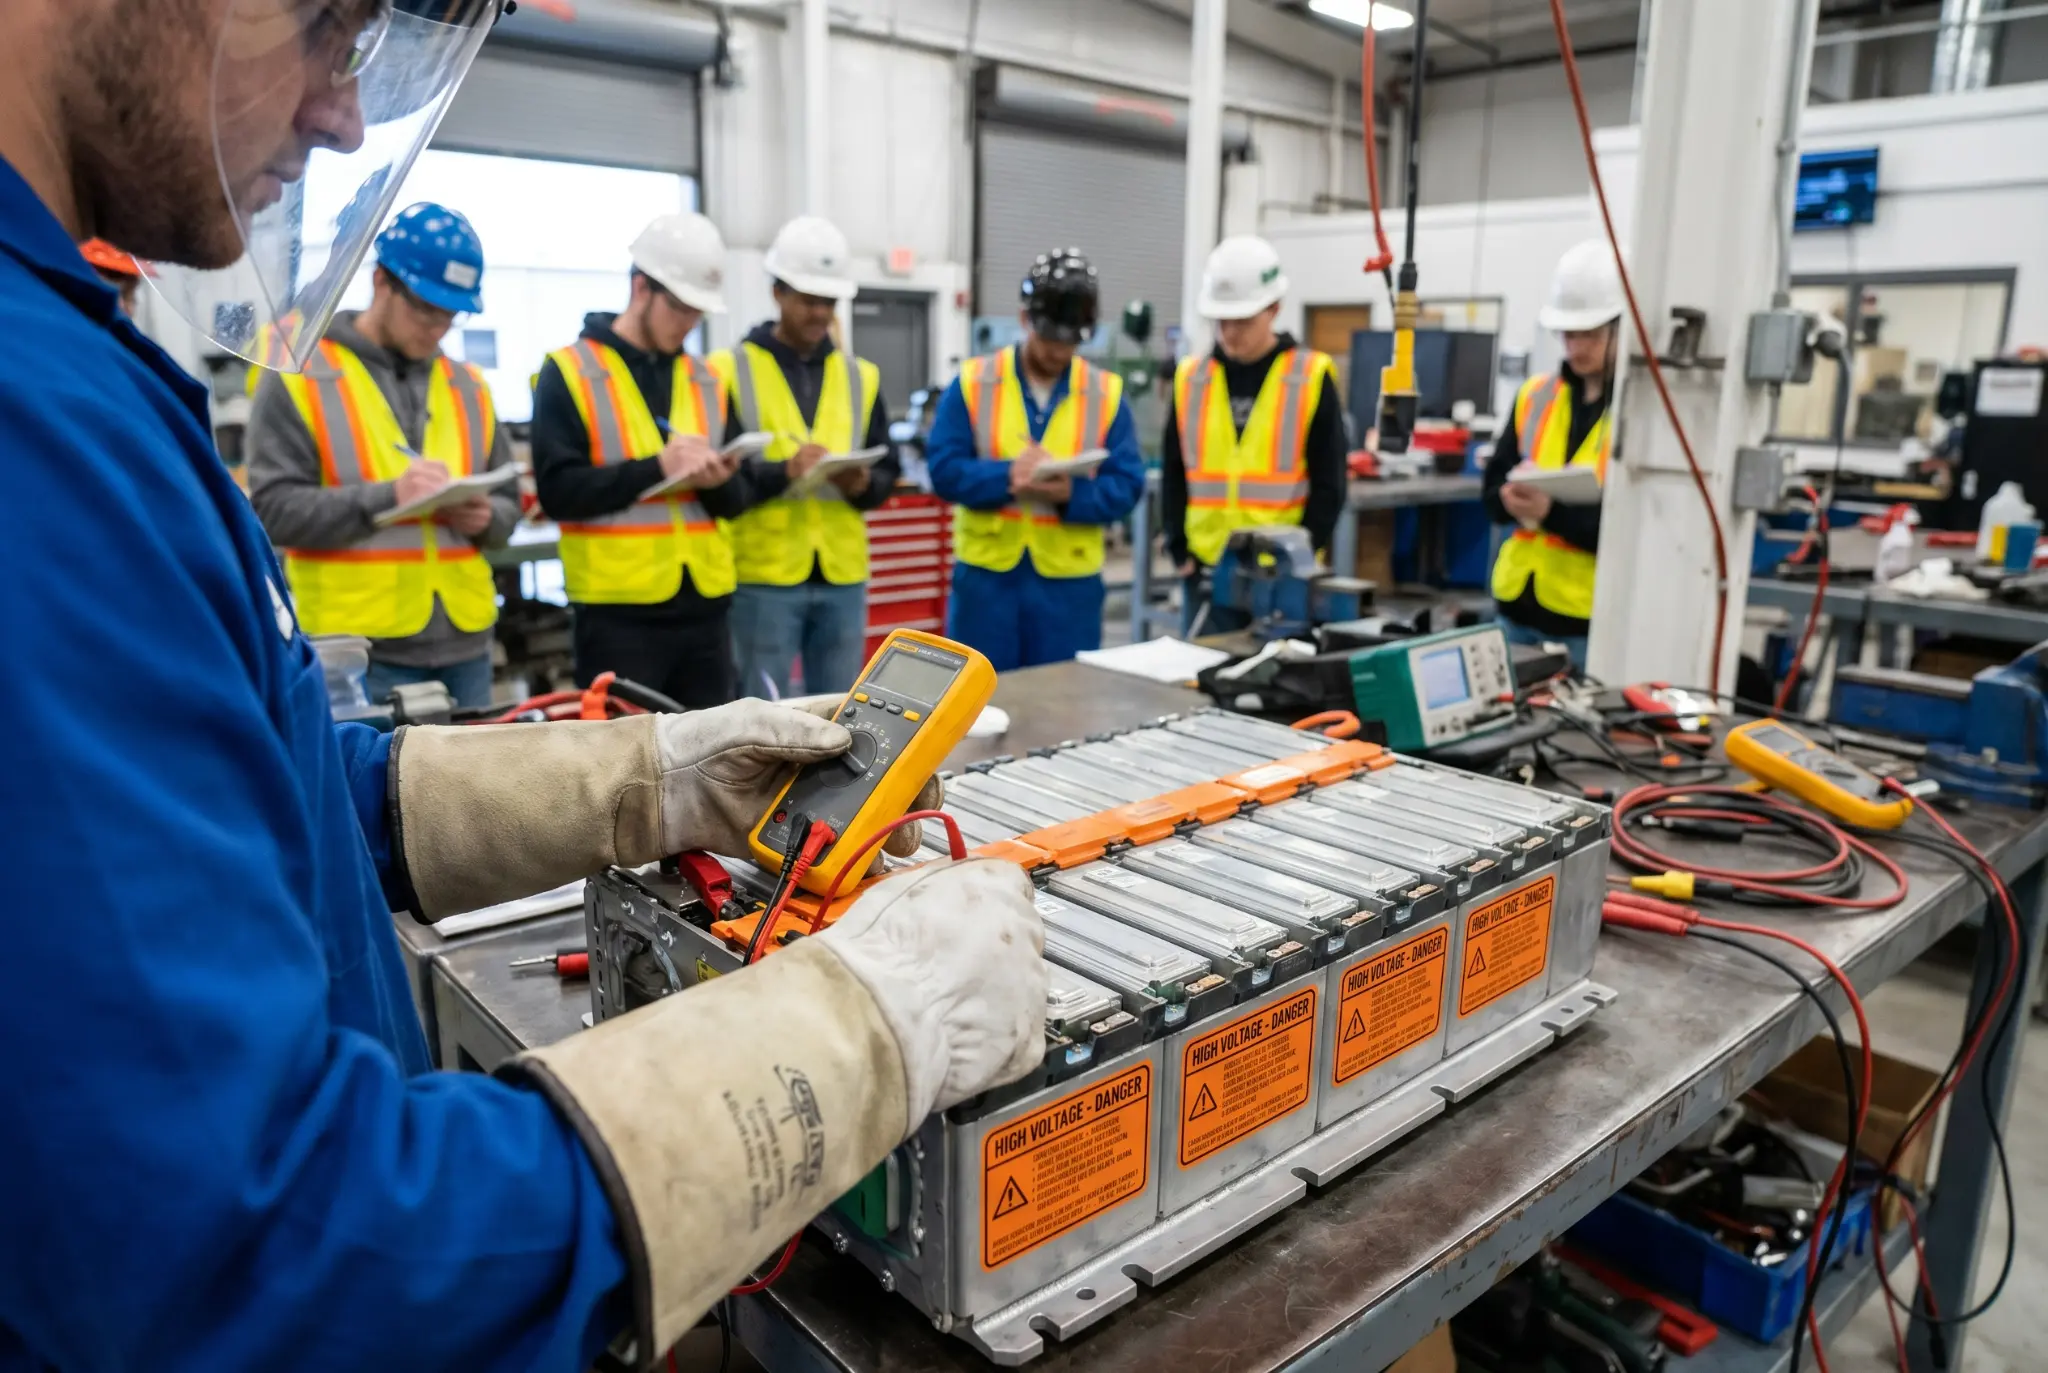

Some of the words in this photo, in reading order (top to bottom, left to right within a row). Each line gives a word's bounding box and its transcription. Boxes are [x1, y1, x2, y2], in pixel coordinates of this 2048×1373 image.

[1490, 897, 1519, 922] VOLTAGE
[1371, 952, 1405, 981] VOLTAGE
[1411, 935, 1442, 962] DANGER
[1192, 1040, 1218, 1066] HIGH
[1221, 1019, 1263, 1053] VOLTAGE
[1271, 998, 1309, 1030] DANGER
[995, 1128, 1026, 1158] HIGH
[1030, 1101, 1084, 1141] VOLTAGE
[1095, 1075, 1141, 1112] DANGER
